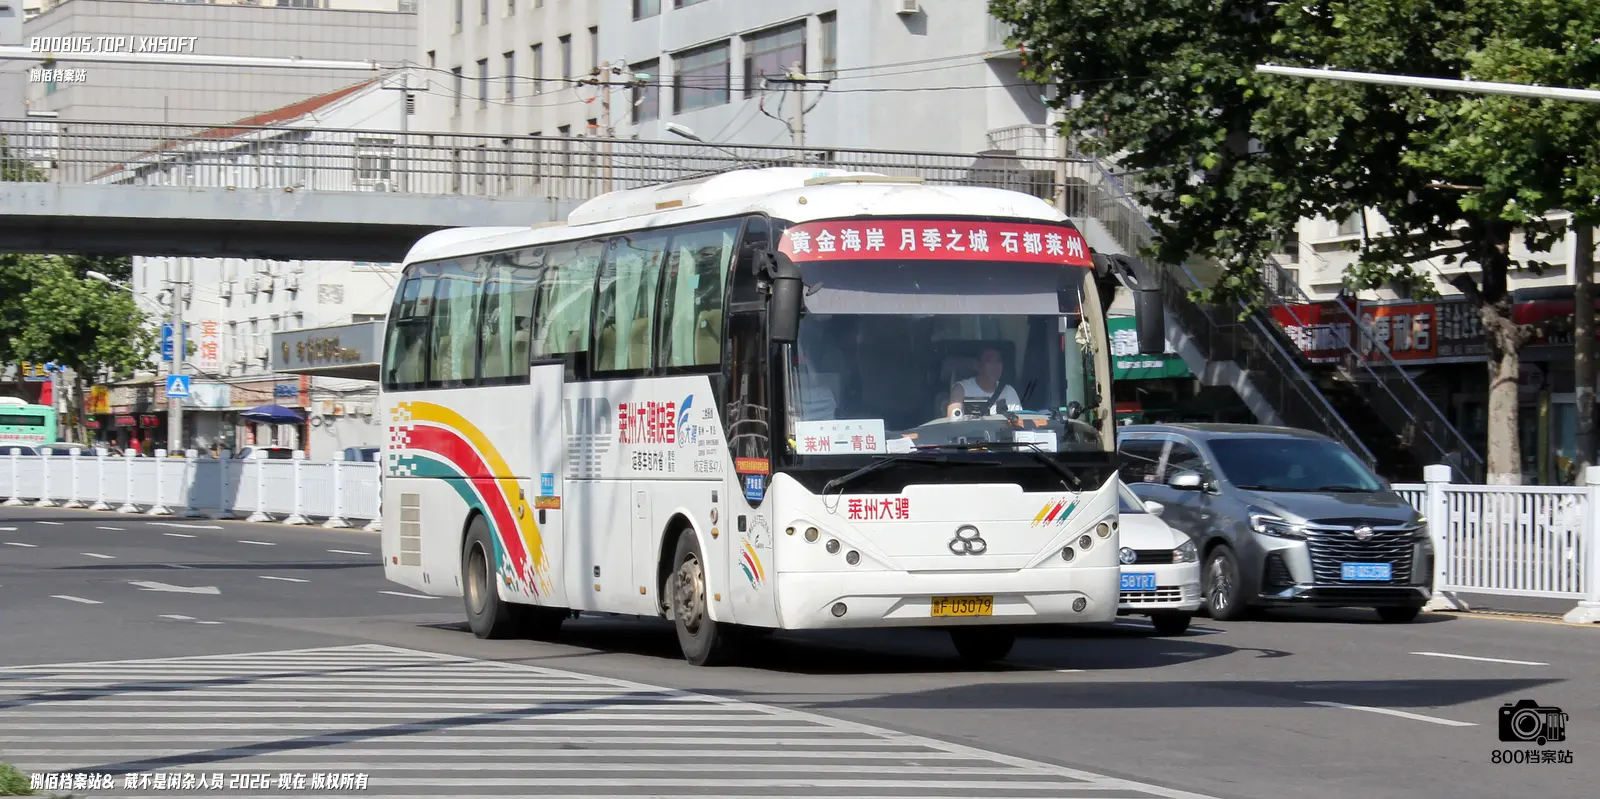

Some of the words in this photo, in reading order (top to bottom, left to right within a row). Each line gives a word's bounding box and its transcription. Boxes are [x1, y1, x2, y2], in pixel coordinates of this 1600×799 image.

[790, 228, 885, 253] 黄金海岸
[900, 228, 989, 252] 月季之城
[1000, 231, 1085, 259] 石都莱州
[201, 320, 218, 359] 宾馆
[563, 397, 613, 484] VIP
[618, 400, 675, 444] 莱州大骋快客
[848, 498, 909, 519] 莱州大骋
